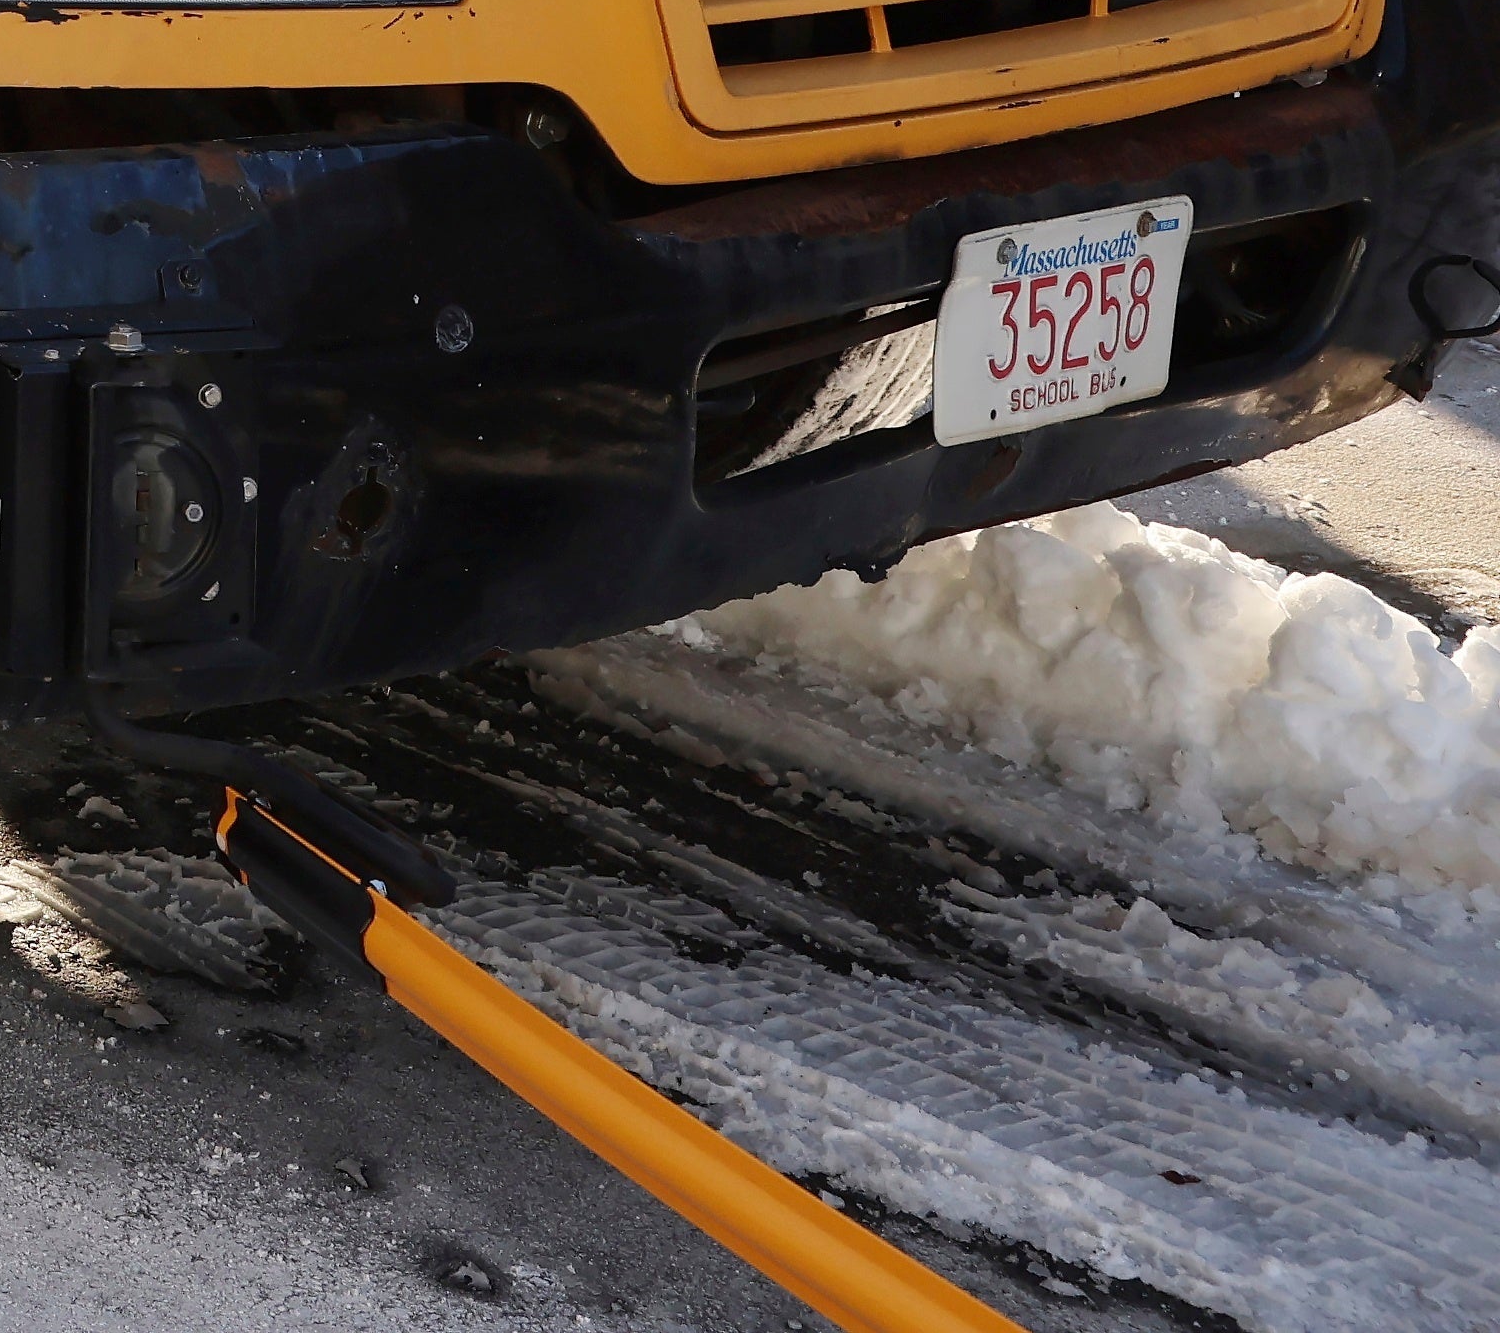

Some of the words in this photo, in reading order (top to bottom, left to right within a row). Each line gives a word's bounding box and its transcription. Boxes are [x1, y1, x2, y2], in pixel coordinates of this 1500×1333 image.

[1004, 230, 1138, 278] Massachusetts
[988, 256, 1156, 380] 35258
[1010, 380, 1079, 414] SCHOOL
[1089, 367, 1117, 396] BUS
